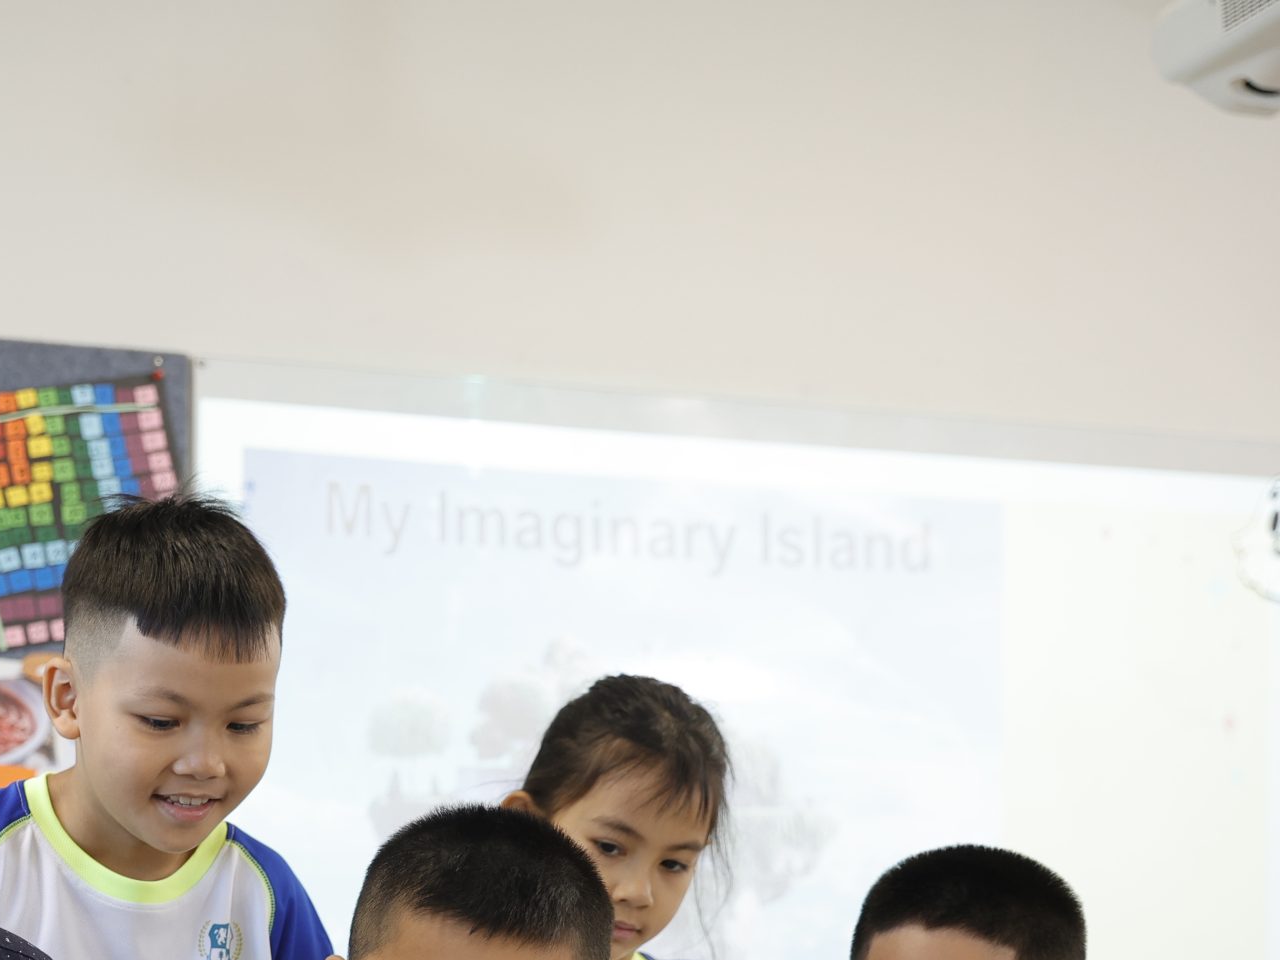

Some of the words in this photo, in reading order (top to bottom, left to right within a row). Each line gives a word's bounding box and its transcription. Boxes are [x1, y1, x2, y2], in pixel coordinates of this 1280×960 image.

[324, 479, 412, 556] My
[436, 489, 739, 579] Imaginary
[759, 510, 933, 575] Island
